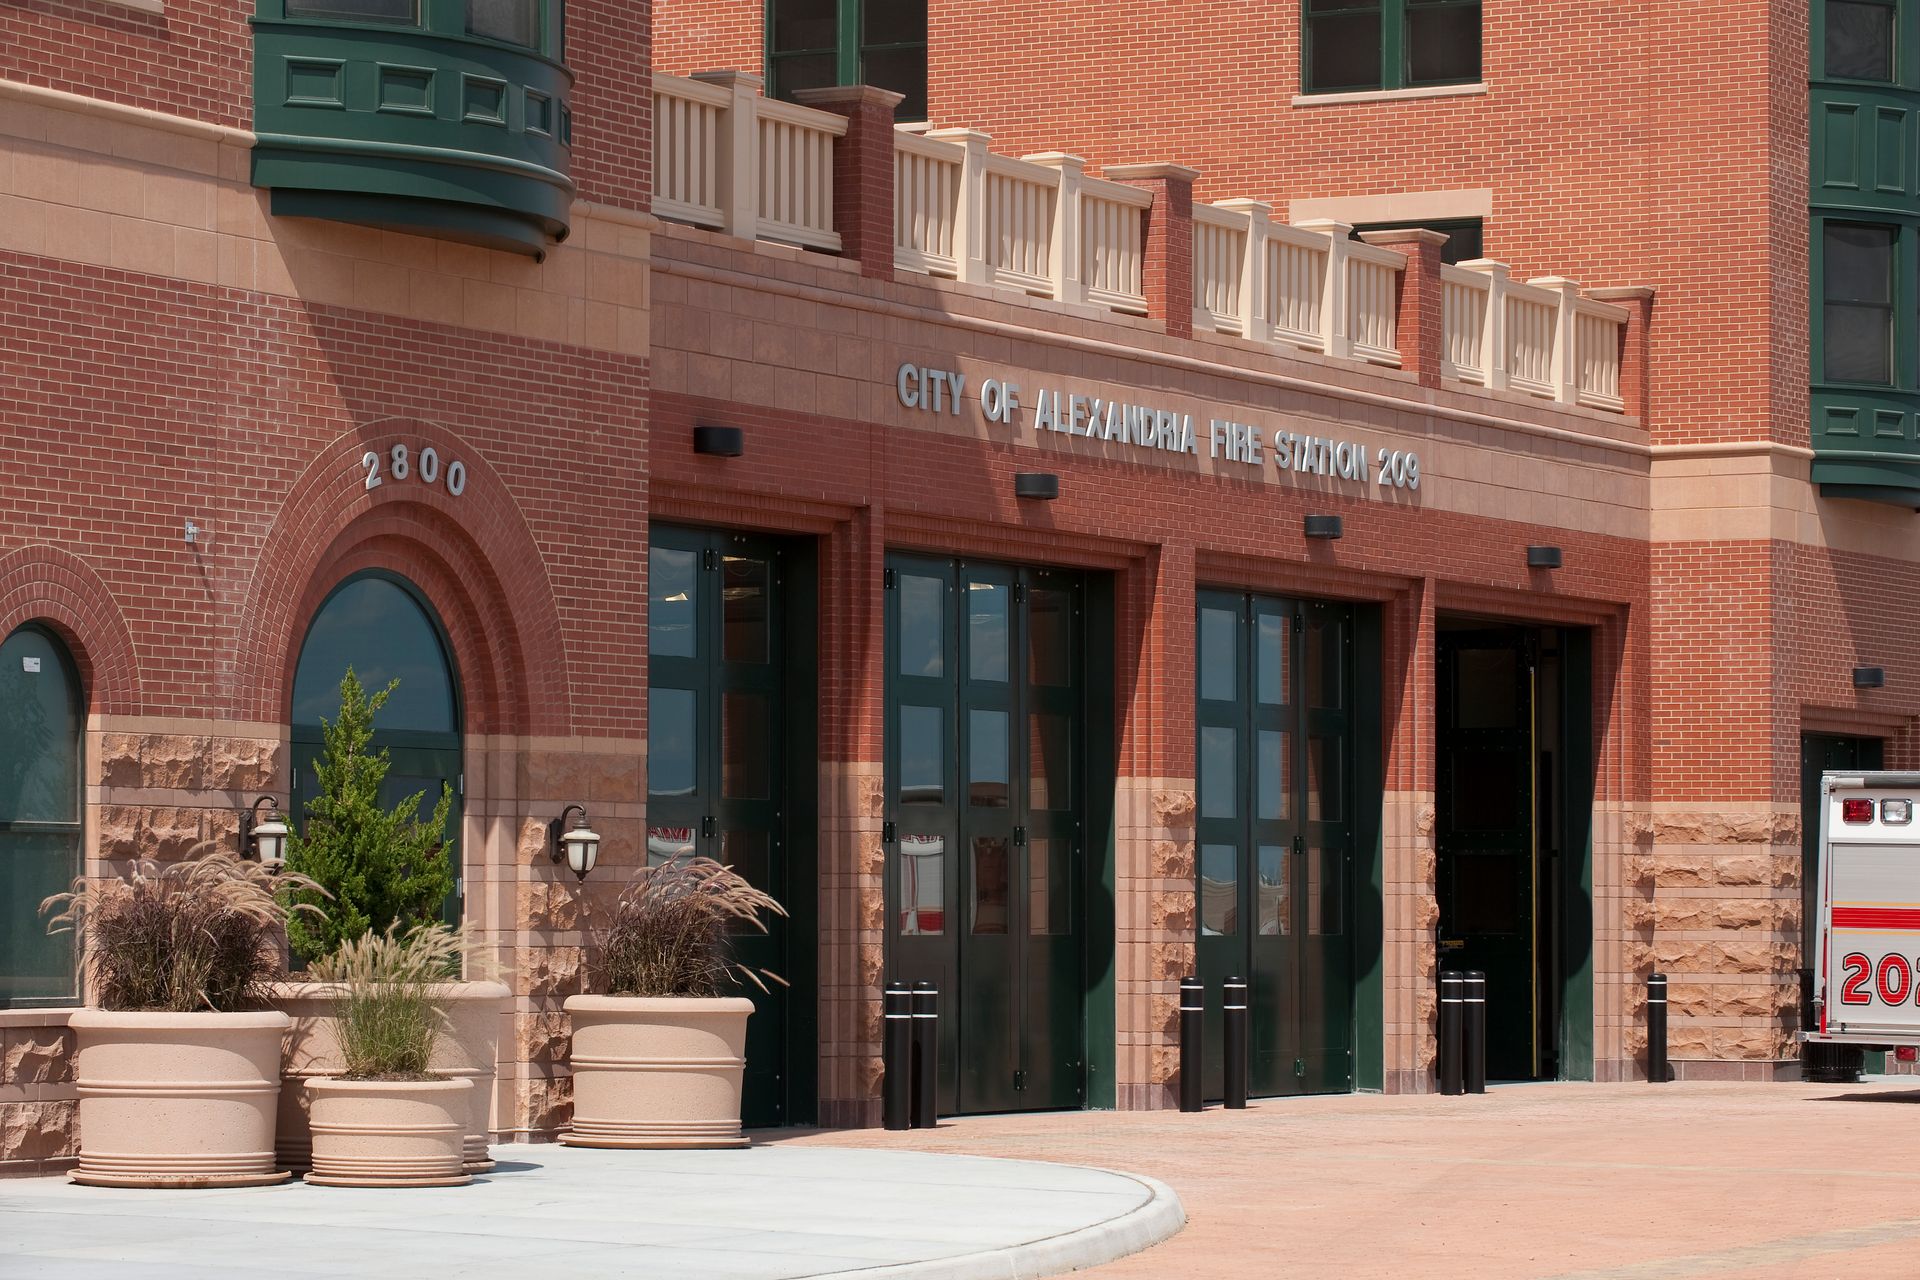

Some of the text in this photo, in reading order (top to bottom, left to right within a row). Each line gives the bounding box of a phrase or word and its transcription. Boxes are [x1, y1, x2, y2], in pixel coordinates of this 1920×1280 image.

[897, 363, 1420, 490] CITY OF ALEXANDRIA FIRE STATION 209
[362, 443, 466, 497] 2800
[1841, 952, 1920, 1007] 20
